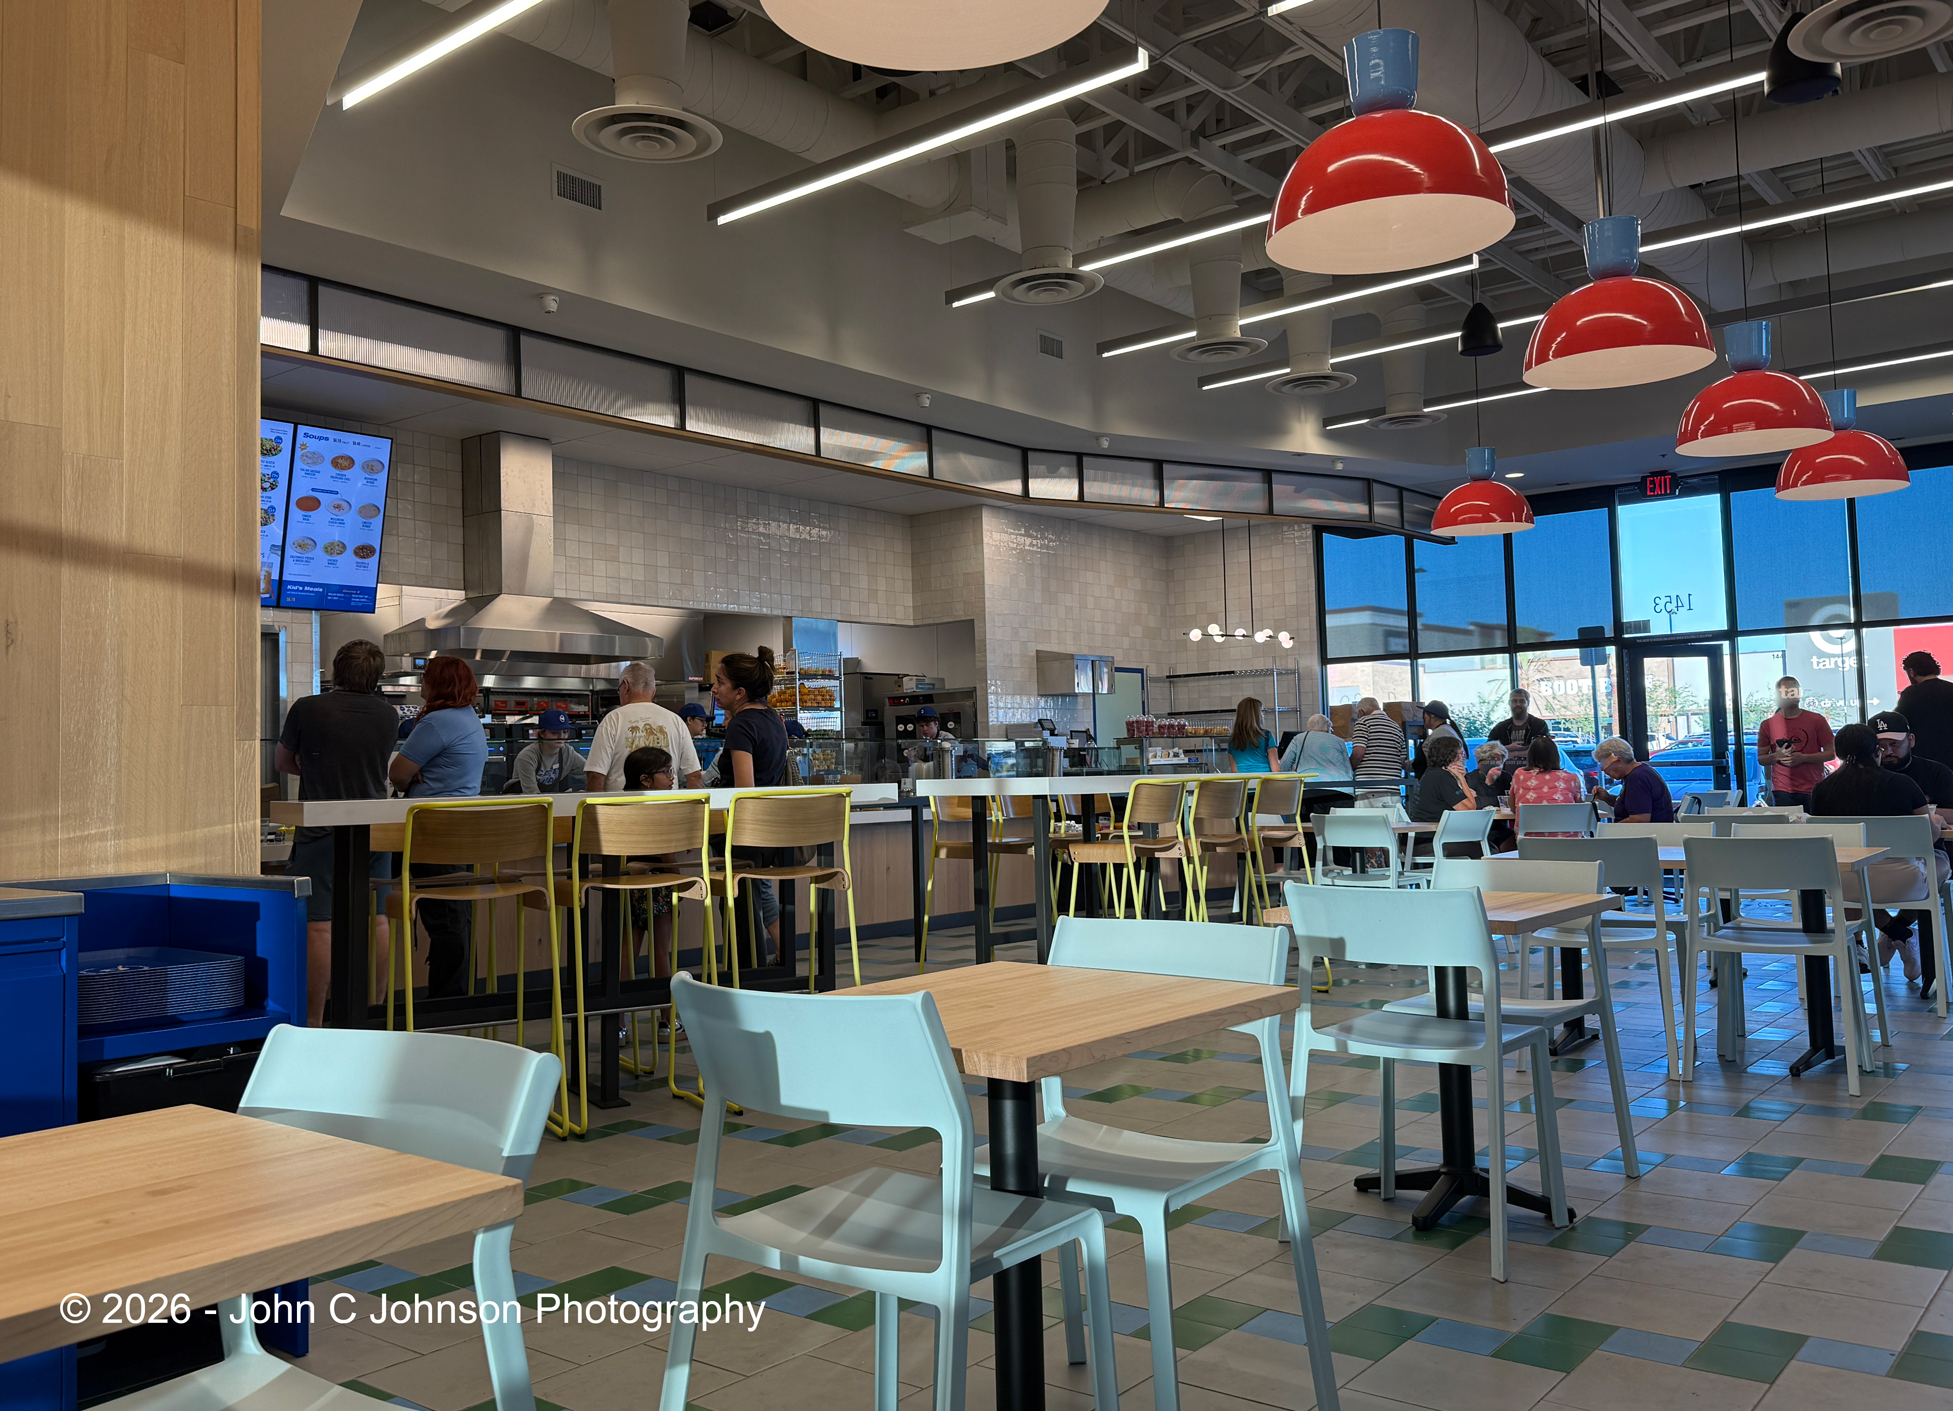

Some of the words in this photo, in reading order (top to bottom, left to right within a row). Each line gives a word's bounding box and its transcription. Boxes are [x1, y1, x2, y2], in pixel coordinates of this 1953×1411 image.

[302, 432, 330, 442] Soups
[1646, 475, 1672, 496] EXIT
[1540, 678, 1592, 696] BOOT
[1876, 718, 1889, 731] LA
